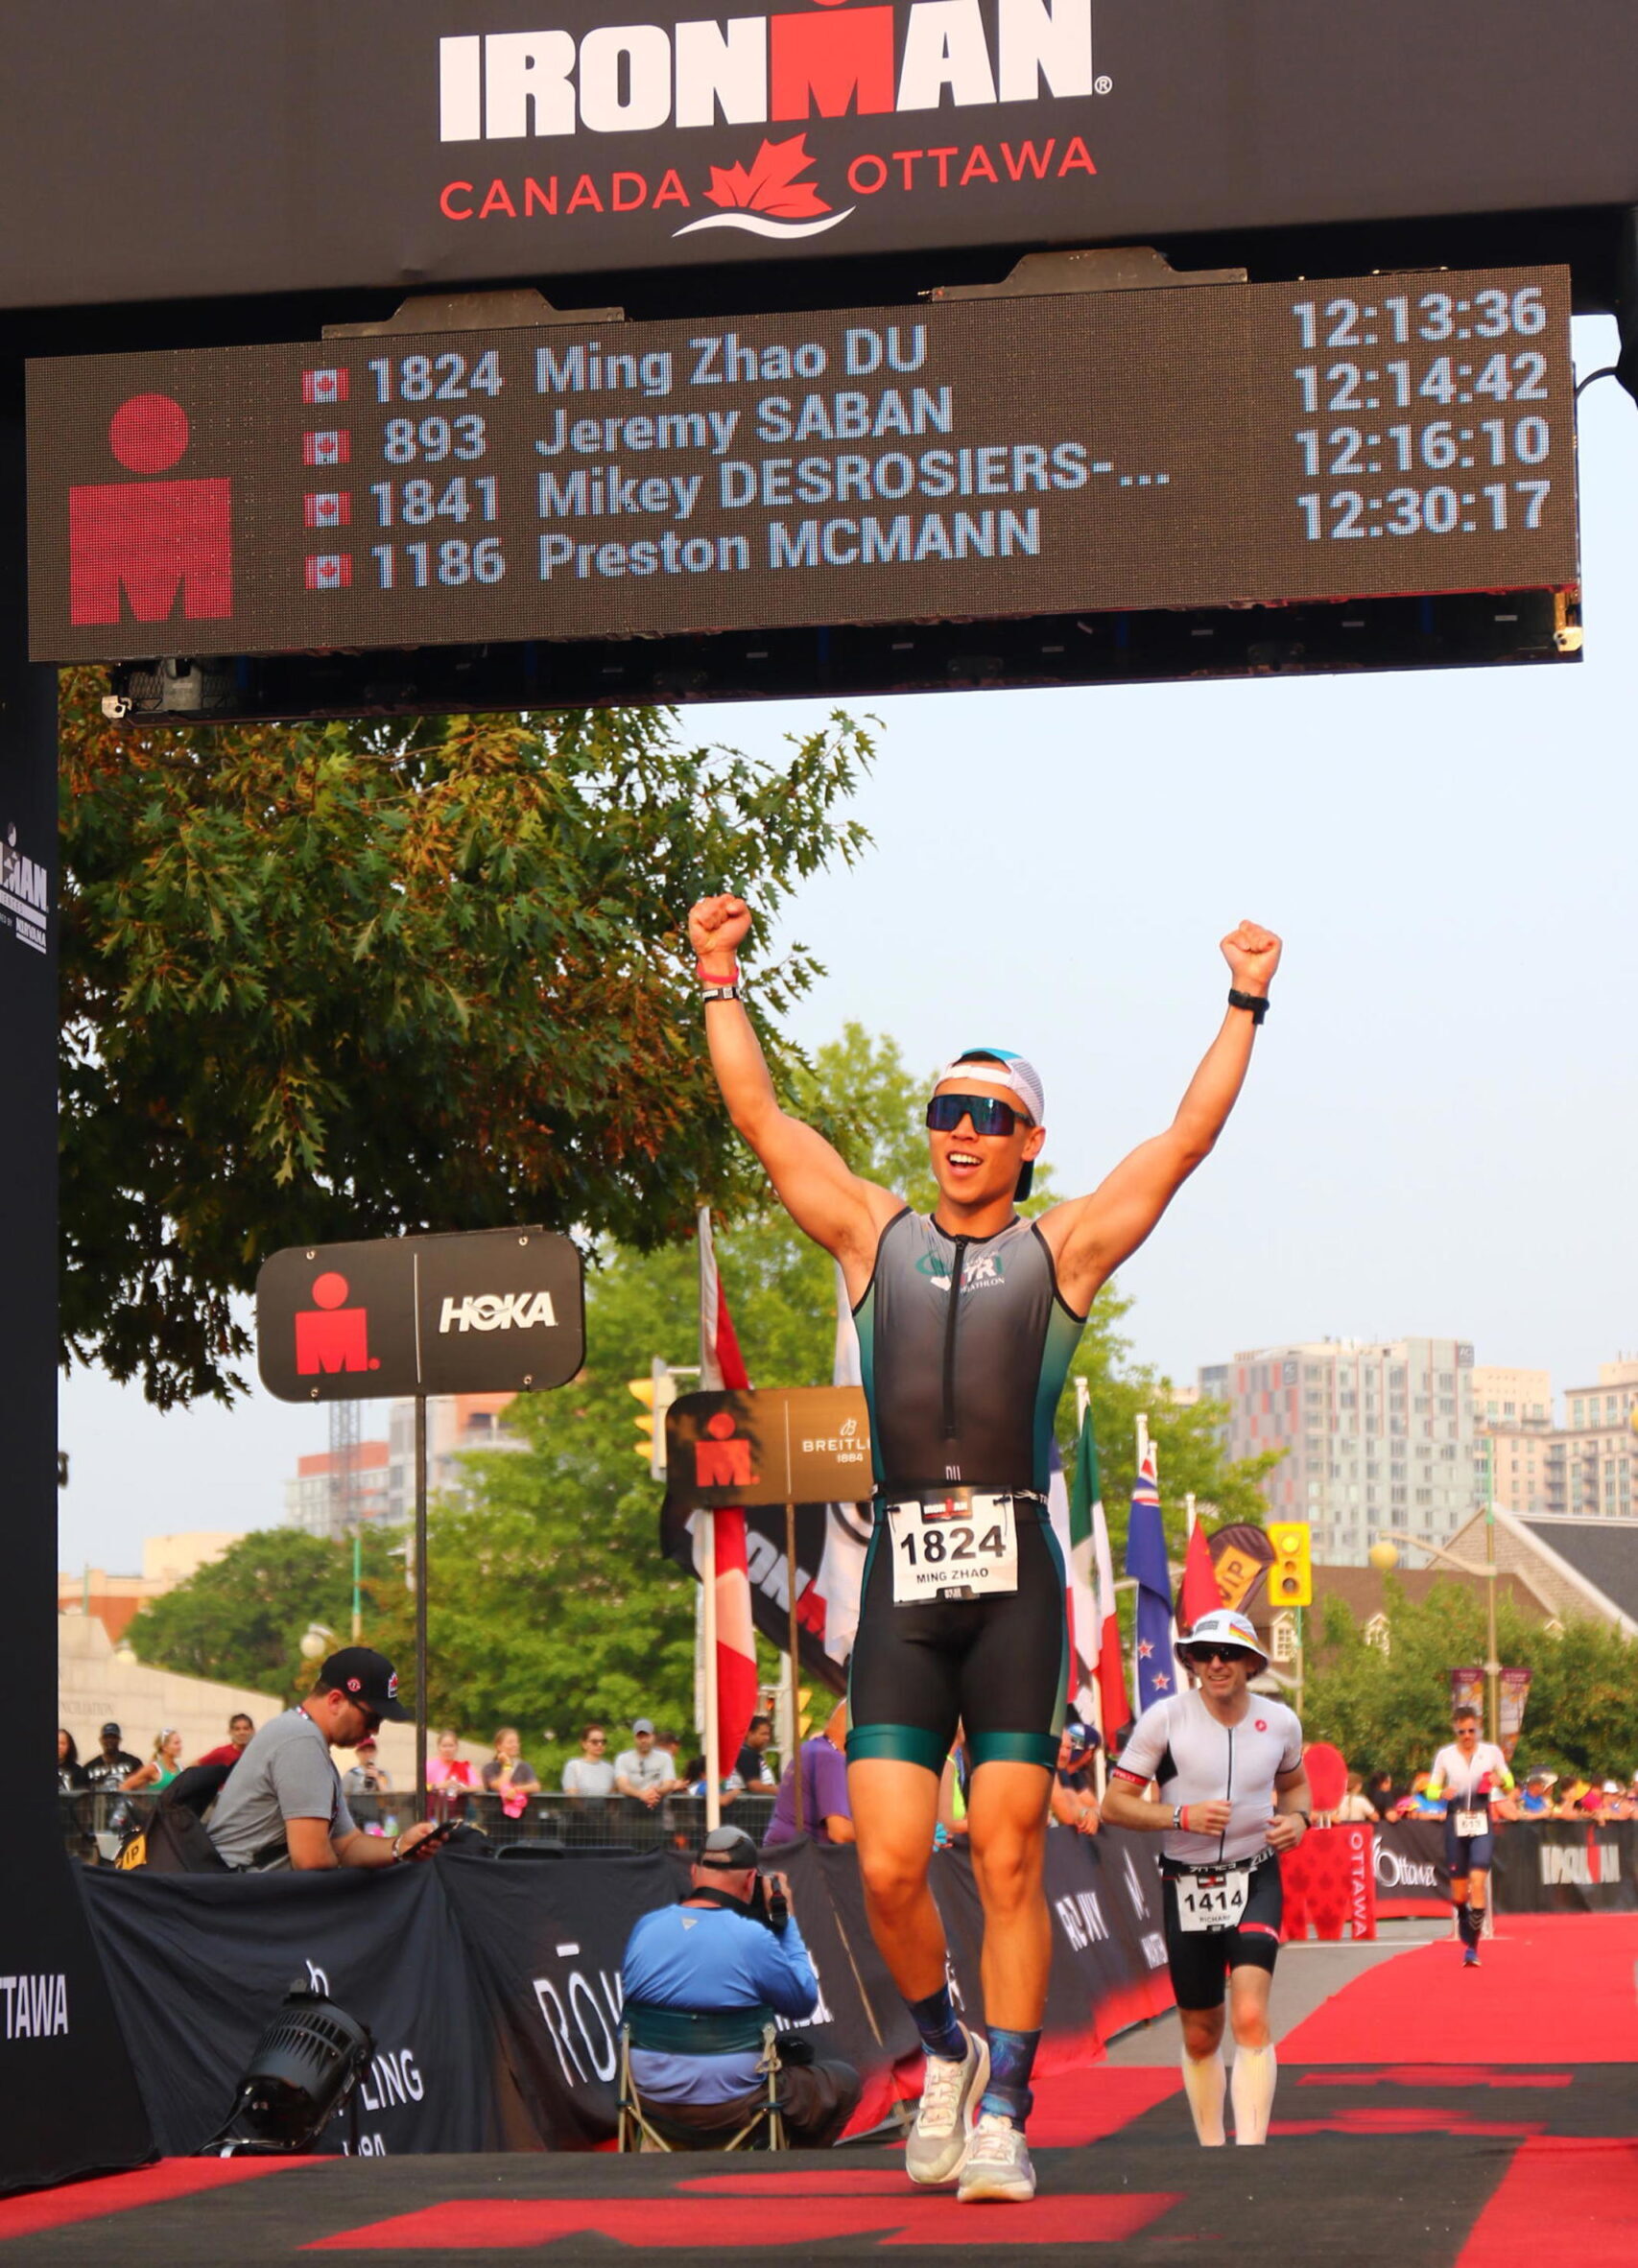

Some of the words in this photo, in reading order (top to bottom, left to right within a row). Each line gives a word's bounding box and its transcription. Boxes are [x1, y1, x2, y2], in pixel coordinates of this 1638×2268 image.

[439, 169, 691, 221] CANADA
[847, 137, 1098, 195] OTTAWA
[370, 350, 504, 403] 1824
[535, 341, 673, 397] Ming
[688, 333, 827, 385] Zhao
[844, 324, 928, 377] DU
[1292, 284, 1549, 350] 12:13:36
[385, 413, 487, 463] 893
[534, 409, 742, 456] Jeremy
[756, 386, 954, 443] SABAN
[1294, 350, 1551, 413] 12:14:42
[372, 477, 498, 527] 1841
[538, 465, 703, 520] Mikey
[1295, 414, 1553, 477] 12:16:10
[373, 537, 507, 588] 1186
[539, 532, 750, 581] Preston
[769, 507, 1042, 569] MCMANN
[1297, 479, 1554, 541] 12:30:17
[439, 1291, 558, 1334] HOKA
[802, 1438, 870, 1453] BREITLI
[837, 1453, 864, 1464] 1884
[900, 1524, 1007, 1566] 1824
[916, 1571, 947, 1584] MING
[951, 1567, 989, 1579] ZHAO
[1184, 1890, 1243, 1912] 1414
[1351, 1832, 1367, 1937] OTTAWA
[0, 1974, 69, 2040] TAWA
[361, 2048, 424, 2112] LING
